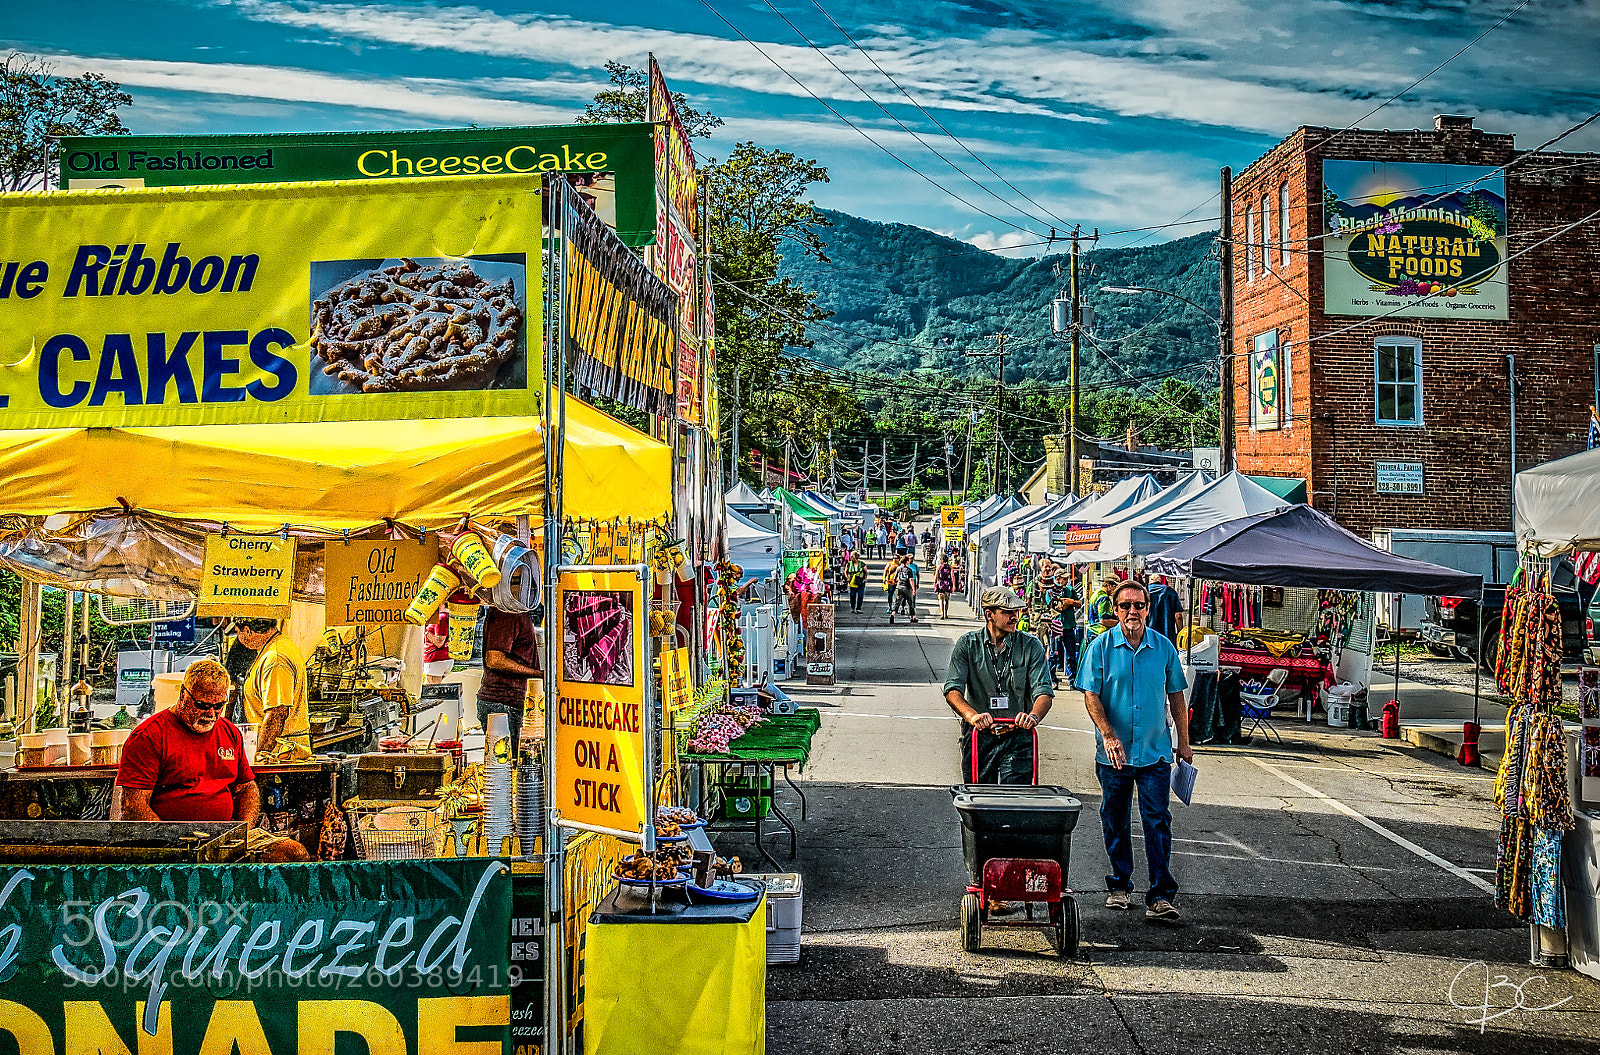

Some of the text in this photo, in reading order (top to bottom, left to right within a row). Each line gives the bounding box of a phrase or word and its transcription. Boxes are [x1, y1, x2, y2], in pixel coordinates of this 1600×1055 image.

[68, 149, 274, 172] Old Fashioned
[357, 145, 608, 177] CheeseCake
[1339, 205, 1472, 233] Black Mountain
[1367, 233, 1480, 258] NATURAL
[63, 242, 260, 297] Ribbon
[1388, 256, 1463, 279] FOODS
[1351, 298, 1369, 306] Herbs
[1375, 299, 1401, 307] Vitamins
[1445, 301, 1467, 310] Organic
[1468, 302, 1496, 310] Groceries
[621, 300, 674, 395] CAKES
[38, 327, 298, 408] CAKES
[229, 538, 272, 552] Cherry
[212, 564, 284, 580] Strawberry
[367, 546, 397, 574] Old
[213, 584, 279, 597] Lemonade
[347, 573, 420, 602] Fashioned
[558, 696, 640, 733] CHEESECAKE
[574, 739, 620, 772] ON A
[574, 778, 621, 813] STICK
[52, 860, 510, 1036] Squeezed
